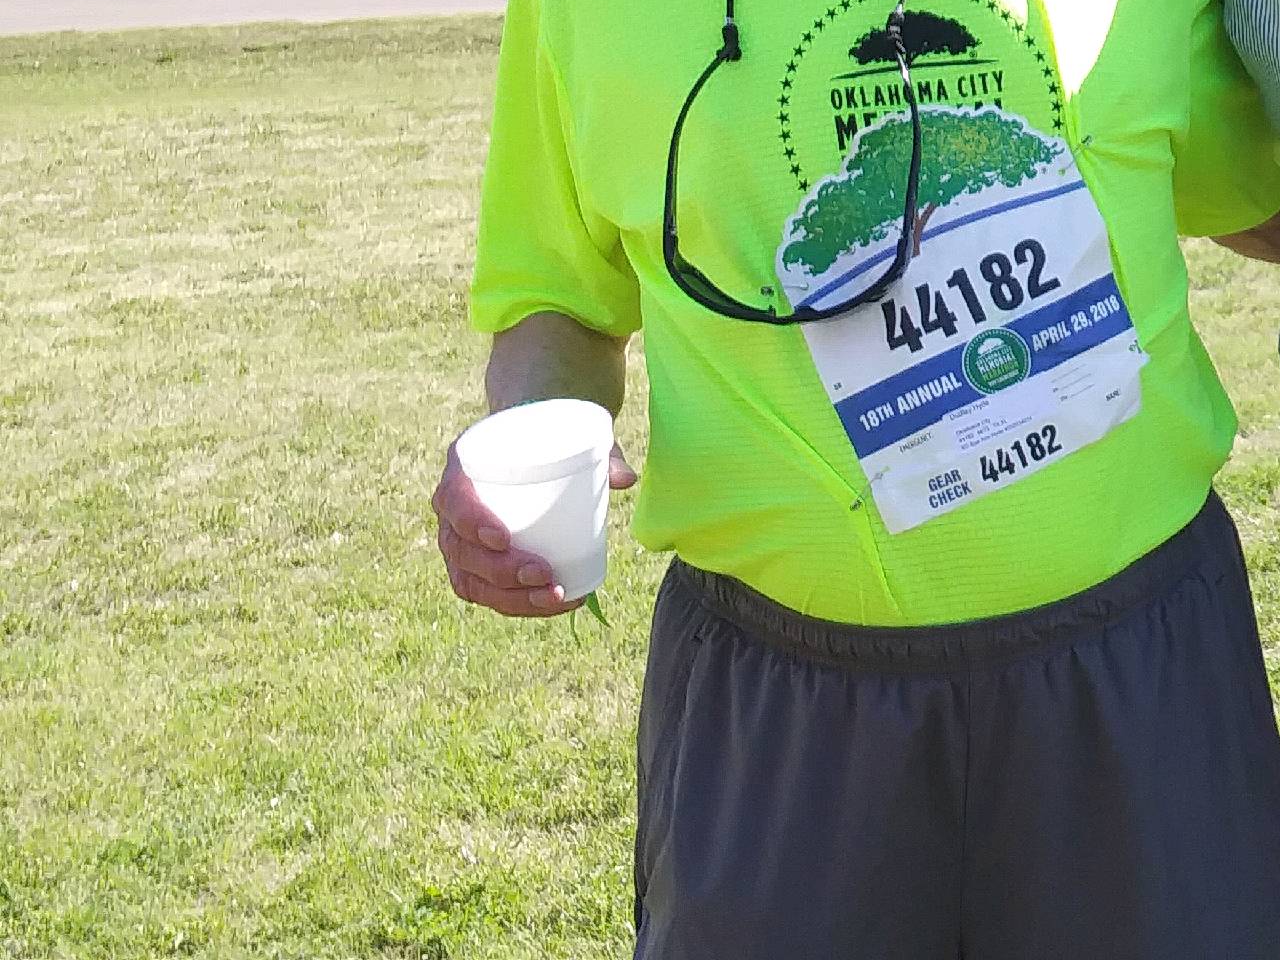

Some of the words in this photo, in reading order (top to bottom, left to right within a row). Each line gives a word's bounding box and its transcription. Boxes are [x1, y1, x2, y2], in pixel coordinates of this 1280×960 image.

[957, 70, 1004, 98] CITY
[881, 238, 1062, 354] 44182
[1031, 320, 1072, 352] APRIL
[1089, 294, 1120, 323] 2018
[858, 402, 895, 432] 18TH
[896, 371, 963, 415] ANNUAL
[928, 469, 962, 492] GEAR
[979, 424, 1063, 483] 44182
[929, 481, 973, 509] CHECK
